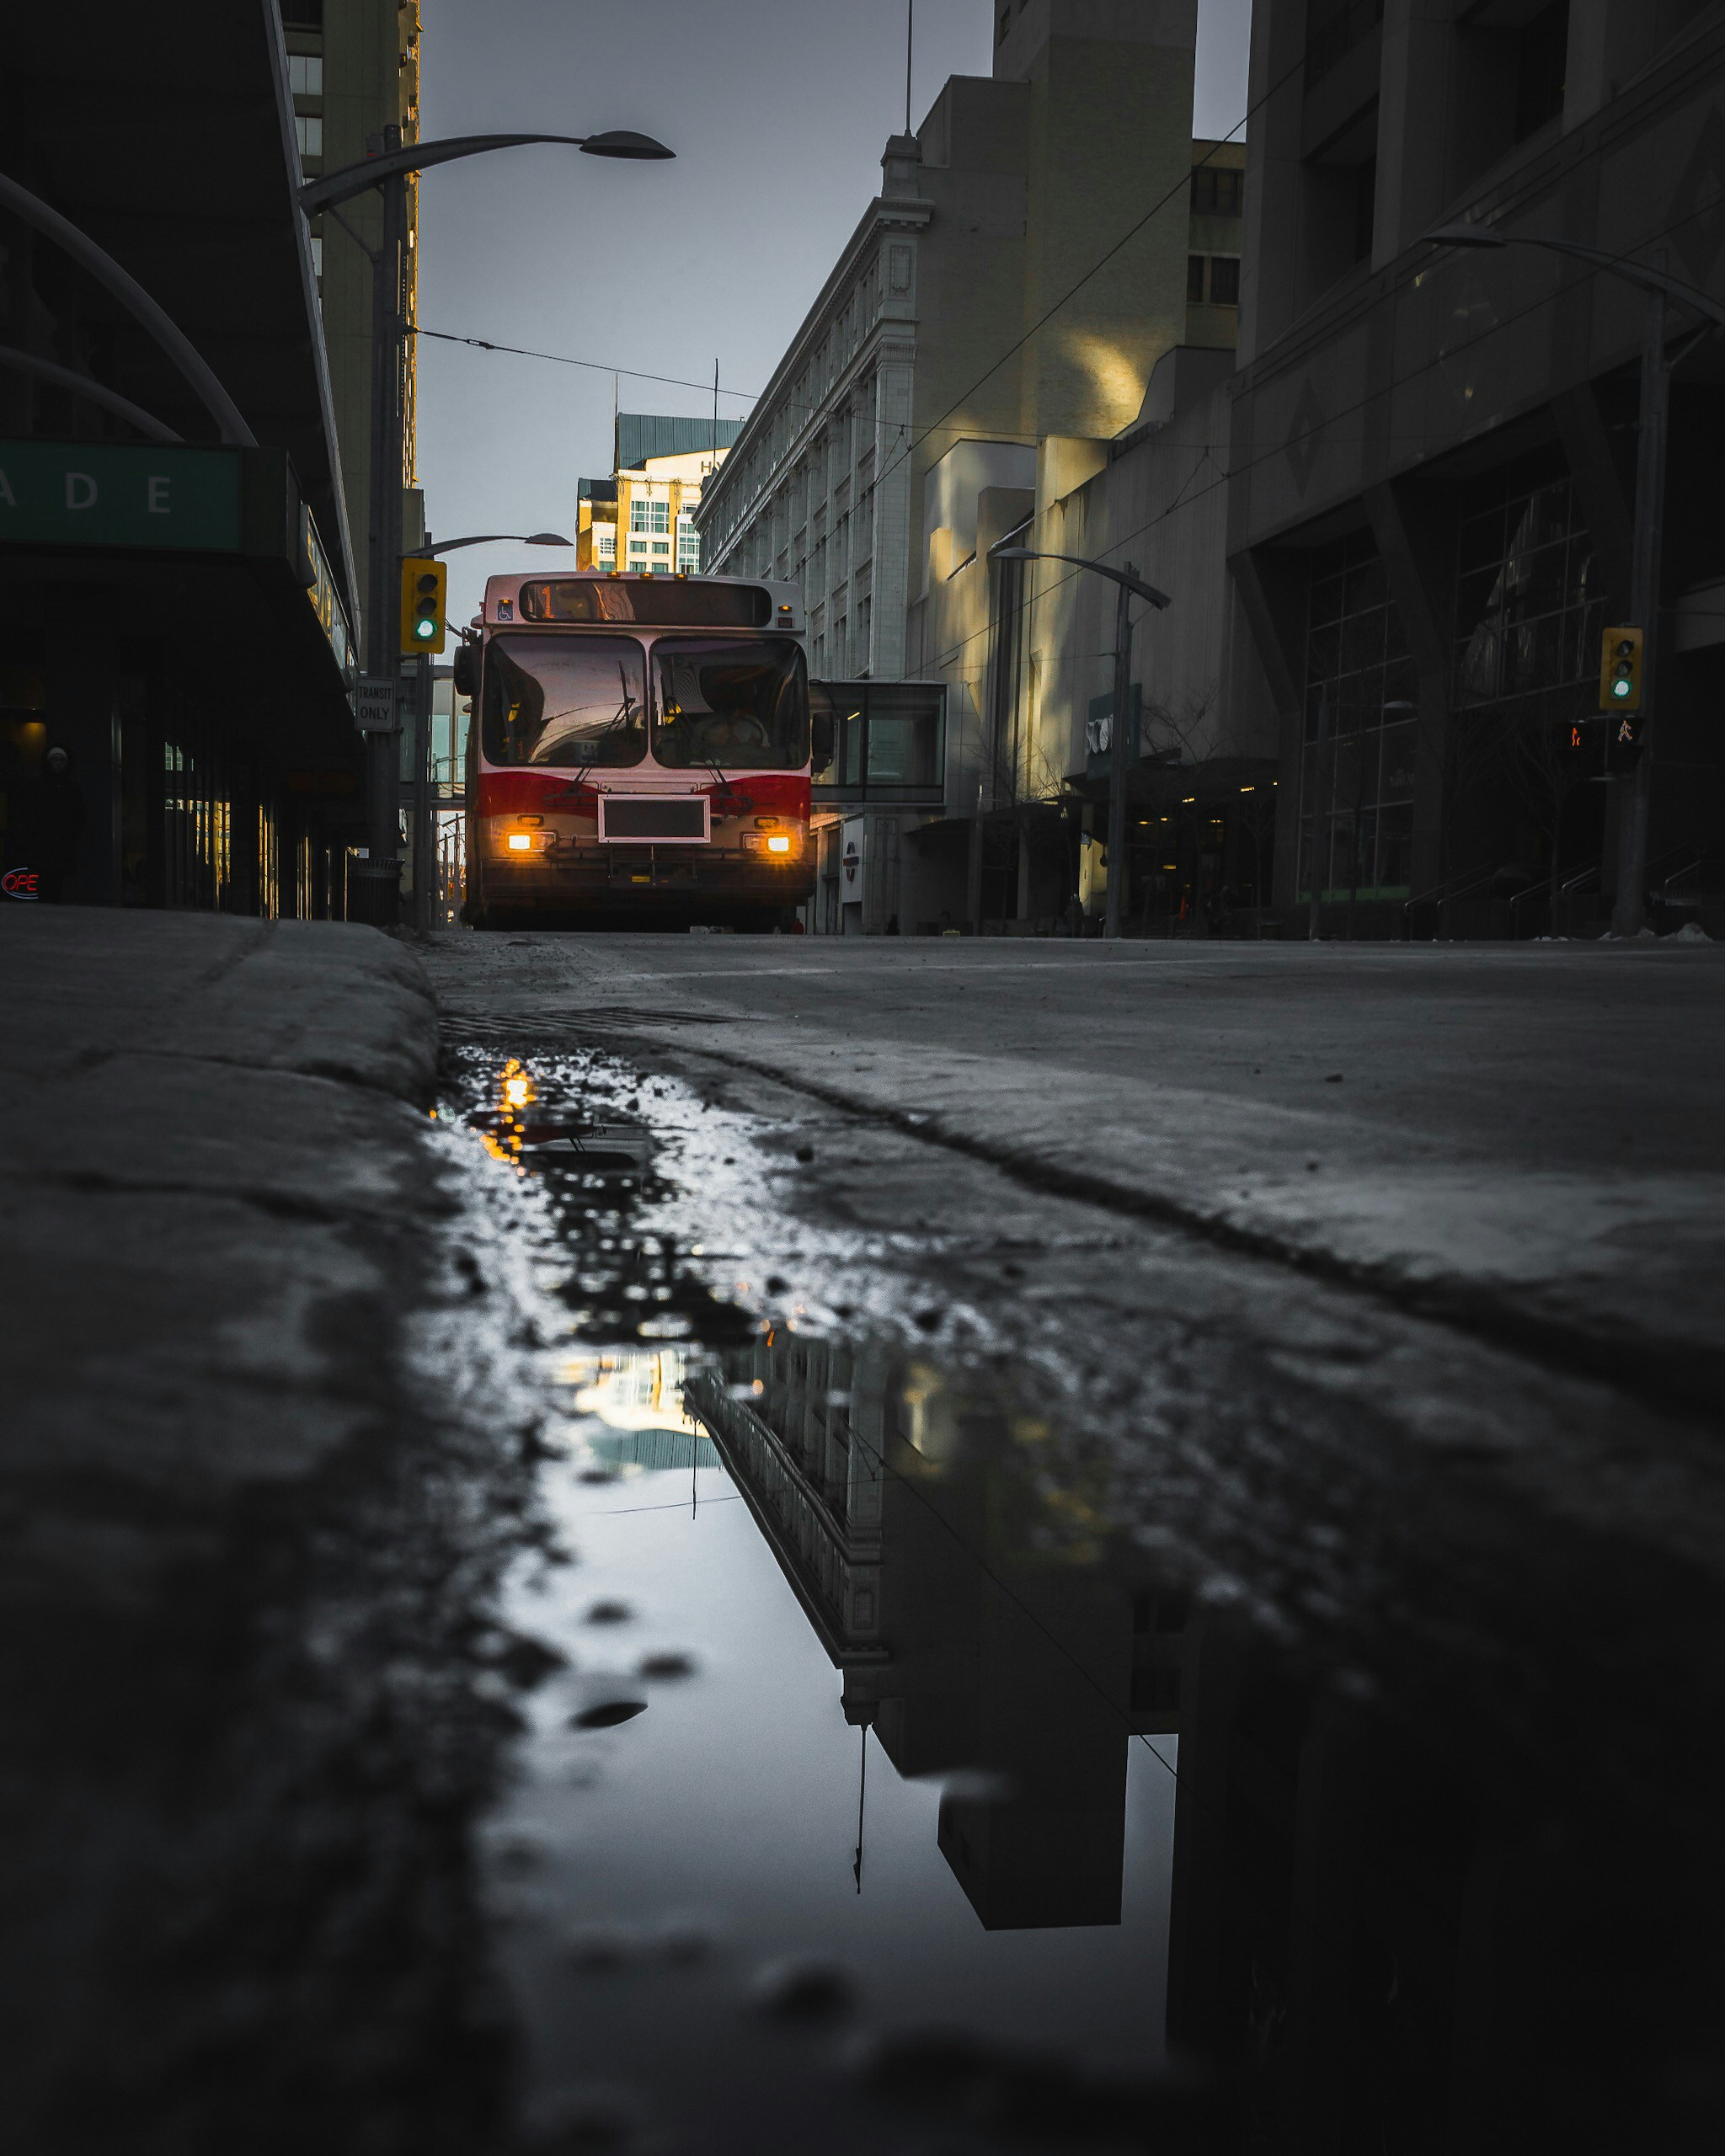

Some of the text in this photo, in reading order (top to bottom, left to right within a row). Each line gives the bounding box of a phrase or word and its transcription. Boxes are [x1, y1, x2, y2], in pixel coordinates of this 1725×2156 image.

[542, 585, 555, 619] 1
[359, 686, 391, 700] TRANSIT
[360, 707, 389, 720] ONLY
[3, 873, 40, 891] OPE
